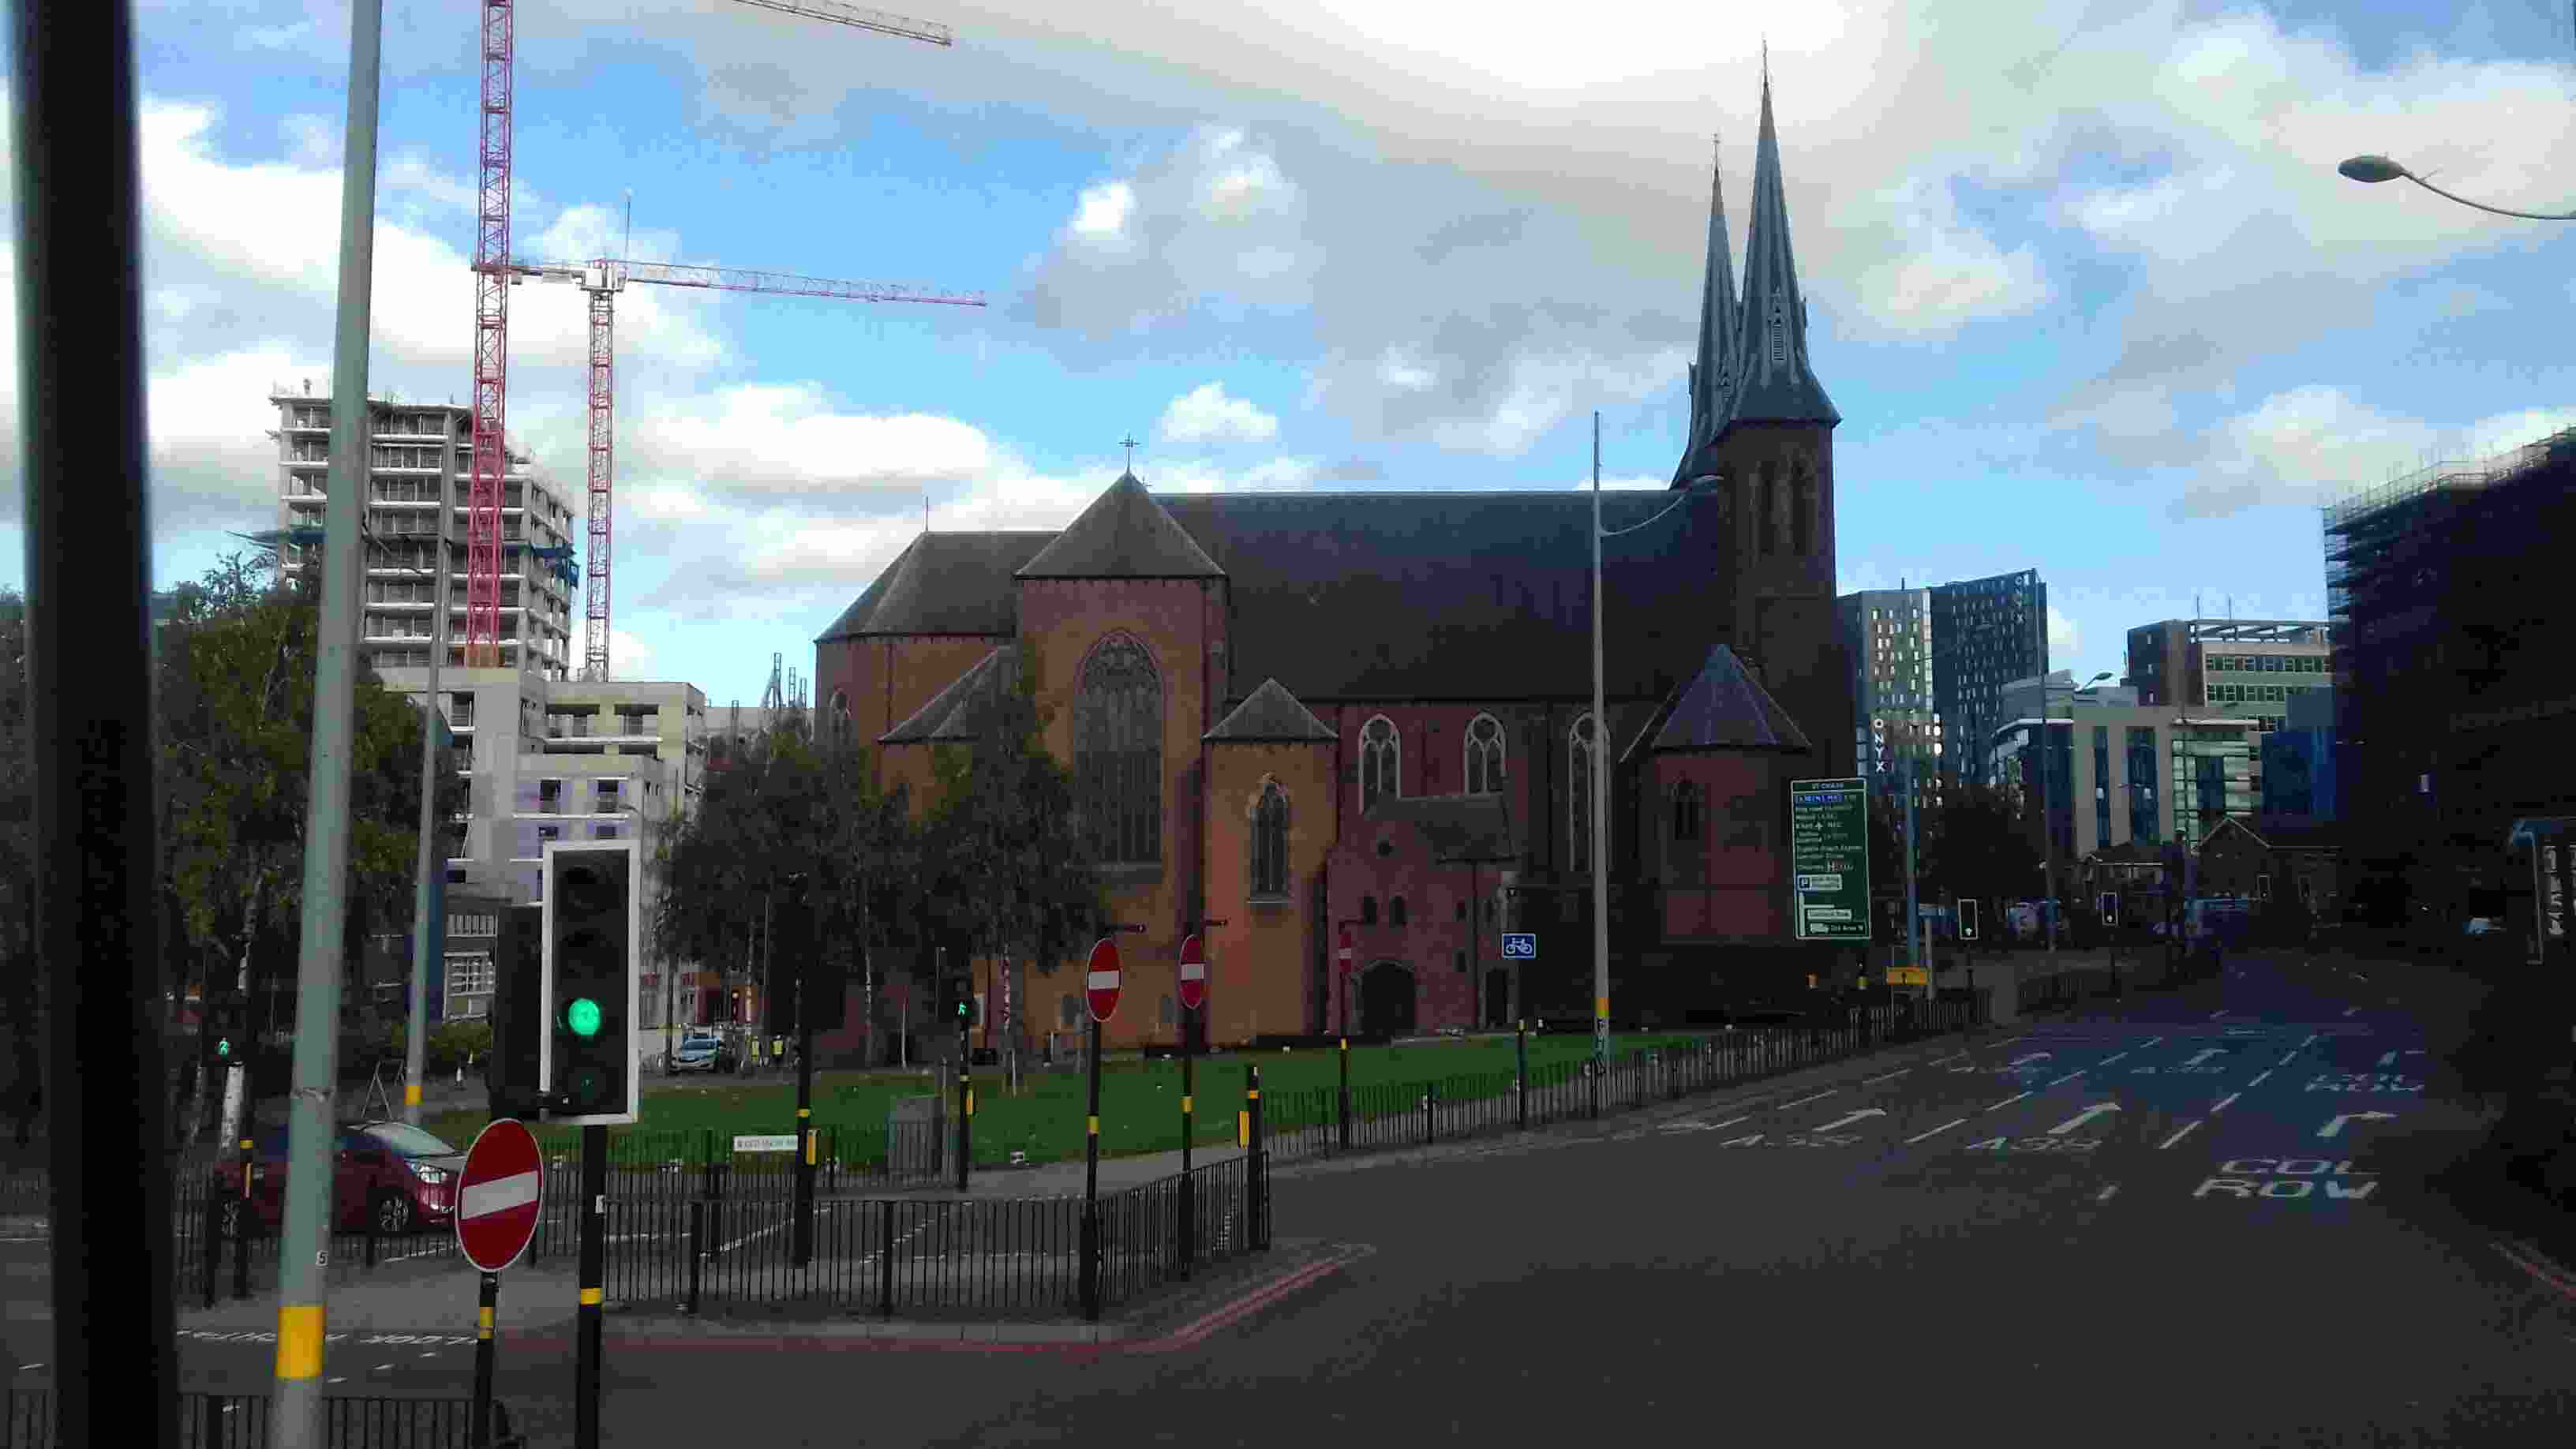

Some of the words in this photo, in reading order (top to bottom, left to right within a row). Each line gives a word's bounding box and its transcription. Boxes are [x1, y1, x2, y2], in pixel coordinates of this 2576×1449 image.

[1874, 718, 1887, 773] ONYX
[2222, 1158, 2381, 1174] COL
[2190, 1178, 2378, 1199] ROW
[318, 1251, 328, 1267] 5
